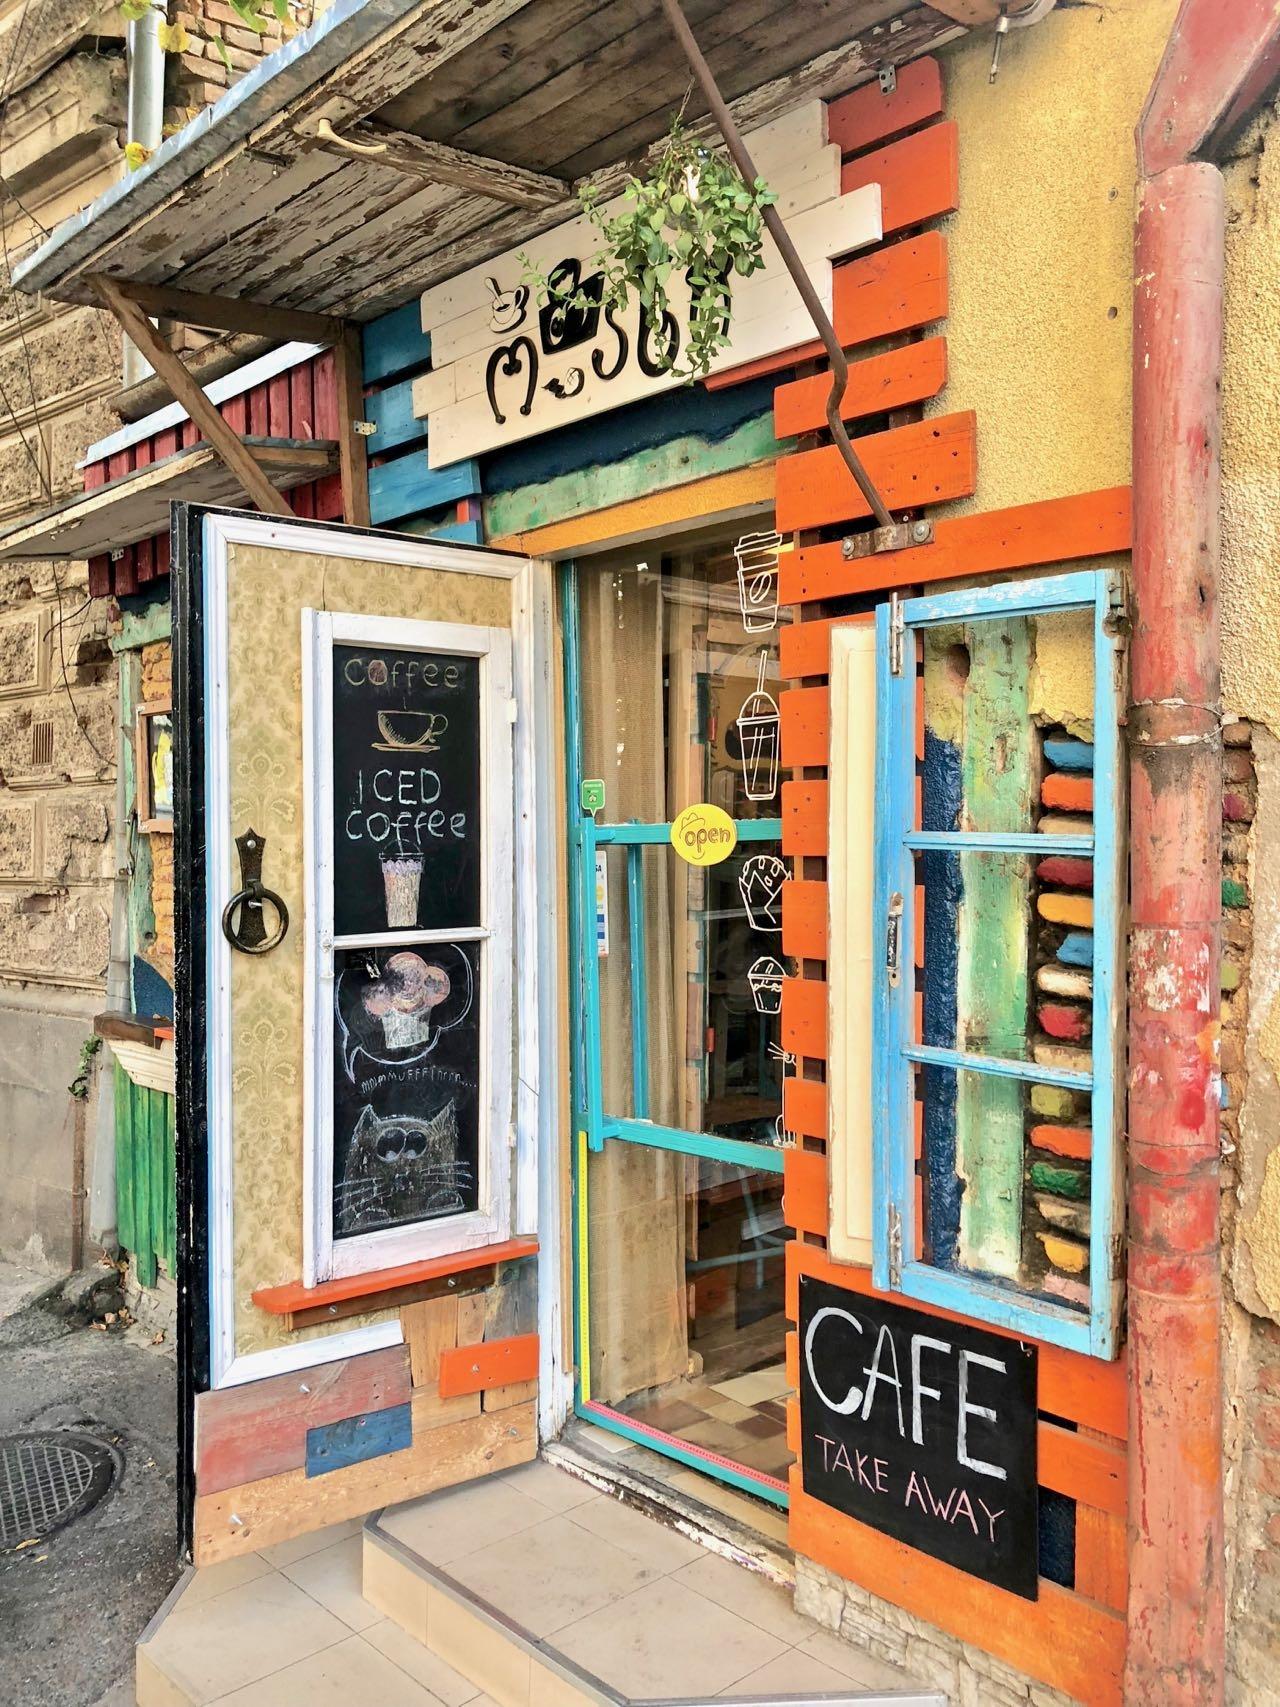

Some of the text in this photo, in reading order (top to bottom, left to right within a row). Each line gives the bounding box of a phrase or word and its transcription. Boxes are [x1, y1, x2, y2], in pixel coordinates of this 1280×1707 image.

[359, 767, 441, 805] ICED
[684, 826, 731, 853] open
[805, 1306, 1008, 1481] CAFE
[814, 1434, 889, 1494] TAKE
[904, 1471, 1007, 1542] AWAY
